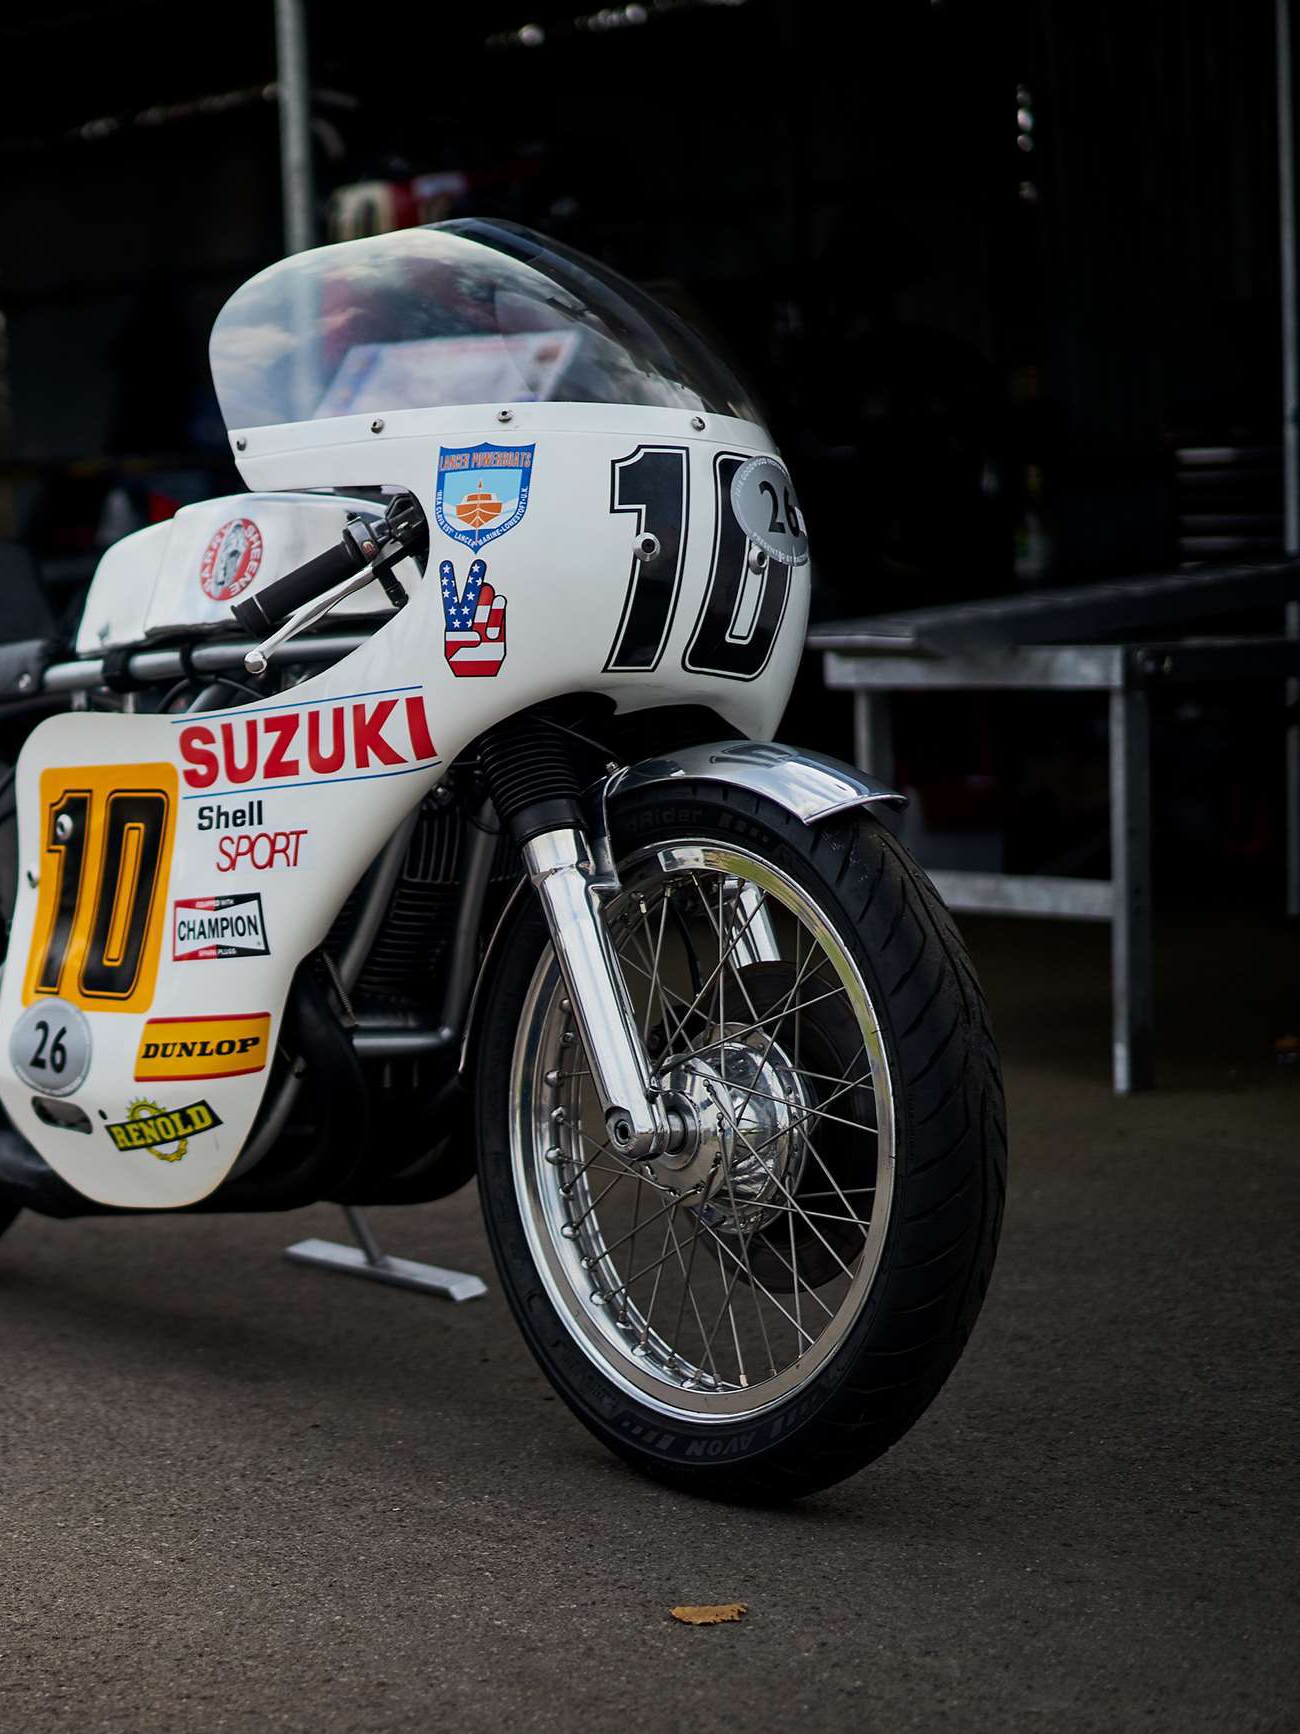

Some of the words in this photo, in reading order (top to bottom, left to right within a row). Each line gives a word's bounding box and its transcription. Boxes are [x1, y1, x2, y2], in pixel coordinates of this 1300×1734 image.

[439, 453, 470, 471] LANCER
[472, 451, 532, 468] POWERBOATS
[758, 480, 801, 538] 26
[228, 524, 262, 596] SHEENE
[601, 444, 794, 683] 10
[178, 695, 438, 789] SUZUKI
[197, 799, 264, 831] Shell
[216, 829, 308, 873] SPORT
[34, 788, 170, 1000] 10
[177, 914, 260, 942] CHAMPION
[29, 1020, 68, 1074] 26
[141, 1036, 261, 1059] DUNLOP
[110, 1103, 215, 1148] RENOLD
[684, 1431, 757, 1458] AVON
